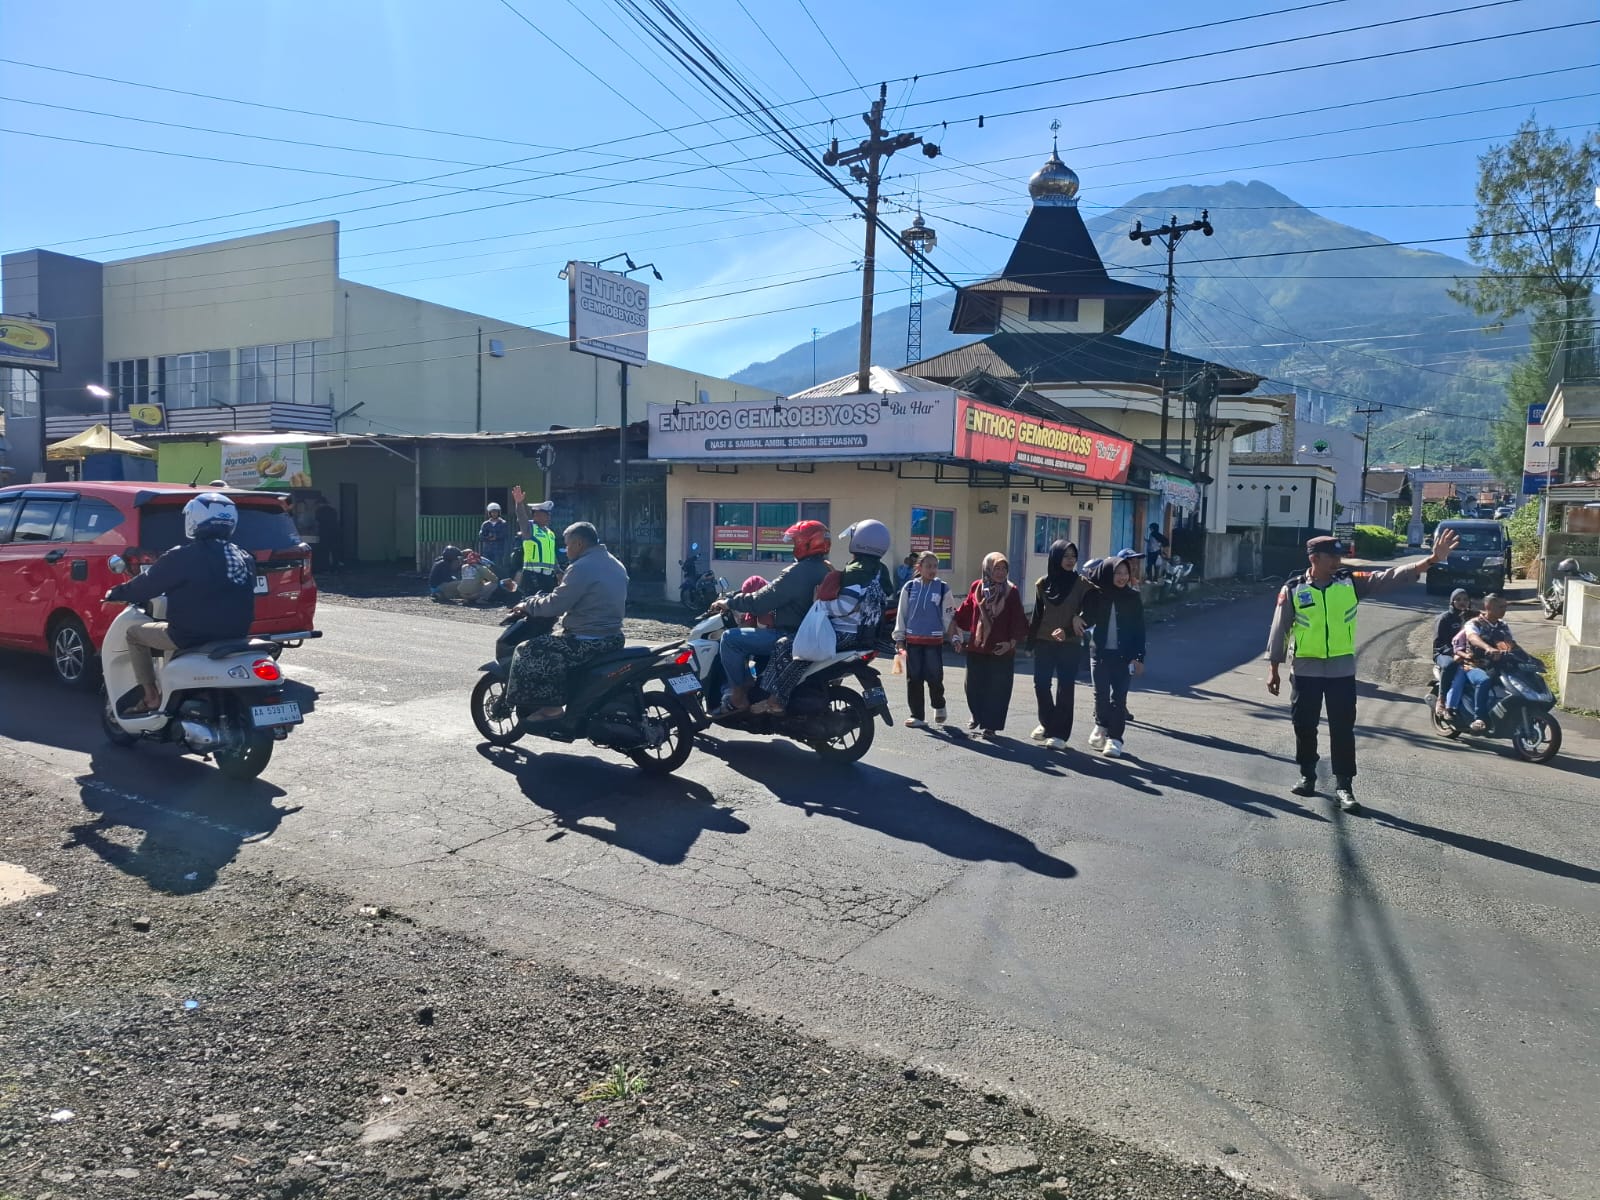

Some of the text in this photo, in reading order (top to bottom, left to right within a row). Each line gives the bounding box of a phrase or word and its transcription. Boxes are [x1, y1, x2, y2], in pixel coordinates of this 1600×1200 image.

[580, 271, 646, 311] ENTHOG
[580, 296, 646, 327] GEMROBBYOSS
[659, 409, 731, 432] ENTHOG
[735, 403, 880, 429] GEMROBBYOSS
[966, 406, 1016, 440] ENTHOG
[1018, 422, 1092, 457] GEMROBBYOSS
[710, 436, 863, 448] NASI & SAMBAL AMBIL SENDIRI SEPUASNYA
